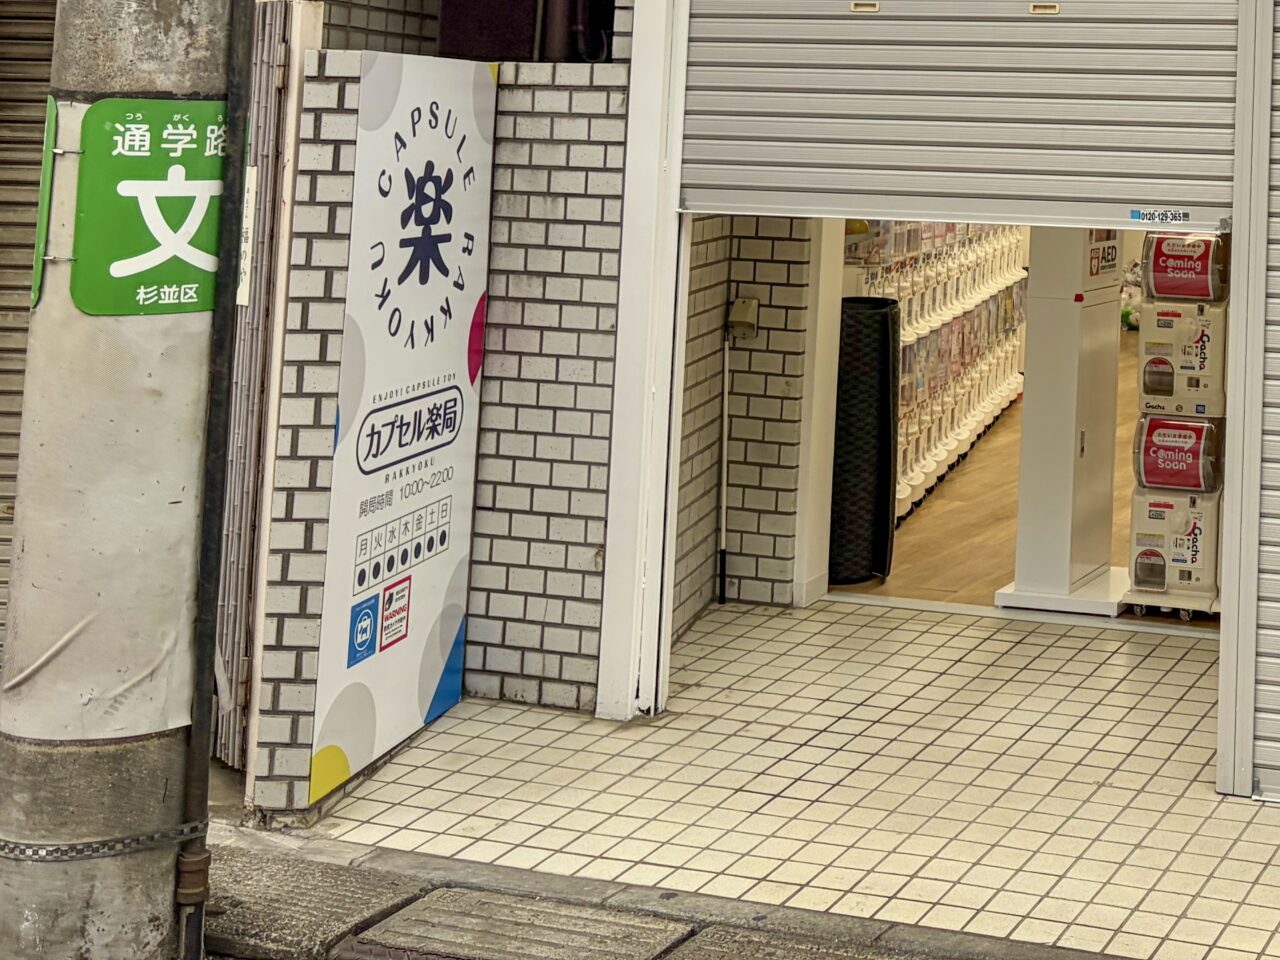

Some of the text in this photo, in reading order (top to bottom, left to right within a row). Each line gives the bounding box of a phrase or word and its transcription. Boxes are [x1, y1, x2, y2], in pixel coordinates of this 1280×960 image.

[378, 101, 476, 198] CAPSULE
[109, 164, 225, 278] 文
[398, 160, 454, 286] 楽
[1141, 212, 1182, 222] 0120-129-365
[1101, 245, 1117, 263] AED
[1160, 257, 1202, 272] Coming
[1167, 268, 1195, 278] Soon
[136, 284, 199, 305] 杉並区
[1199, 334, 1210, 371] Gacha
[372, 372, 456, 404] ENJOY! CAPSULE TOY
[363, 397, 457, 462] カプセル楽局
[1150, 447, 1193, 463] Coming
[1158, 459, 1186, 470] Soon
[384, 456, 435, 485] RAKKYOKU
[359, 503, 448, 558] 月 火 水 木 金 土 日
[1191, 527, 1202, 564] Gacha
